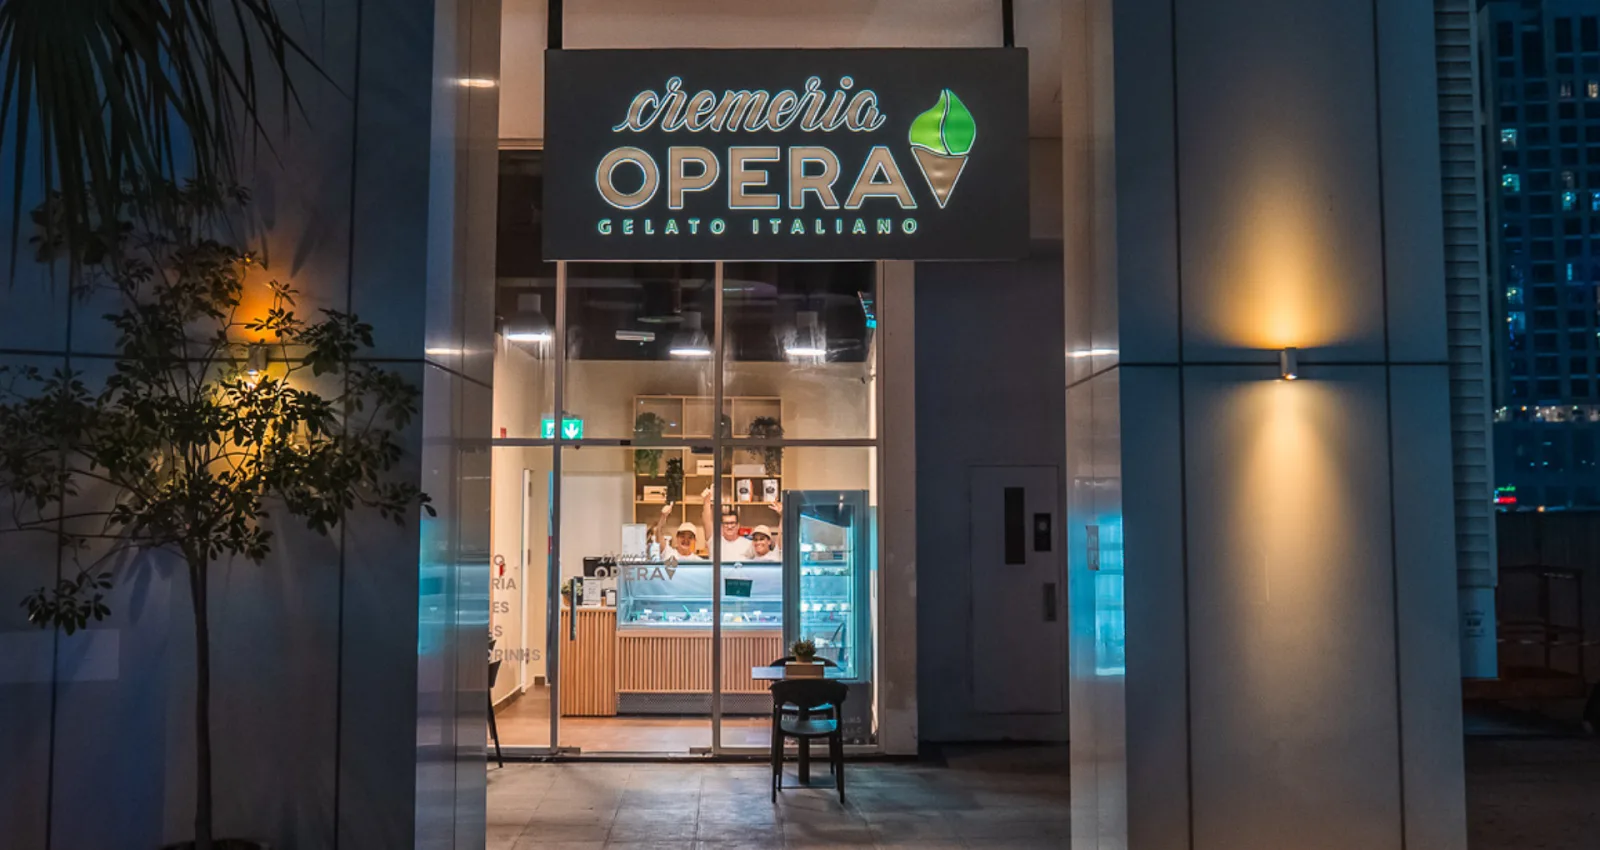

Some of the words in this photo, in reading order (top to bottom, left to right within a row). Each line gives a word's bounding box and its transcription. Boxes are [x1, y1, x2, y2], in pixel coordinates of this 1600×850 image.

[612, 76, 886, 133] cremeria
[595, 146, 918, 210] OPERA
[598, 218, 726, 234] GELATO
[752, 218, 918, 234] ITALIANO
[594, 566, 666, 581] OPERA
